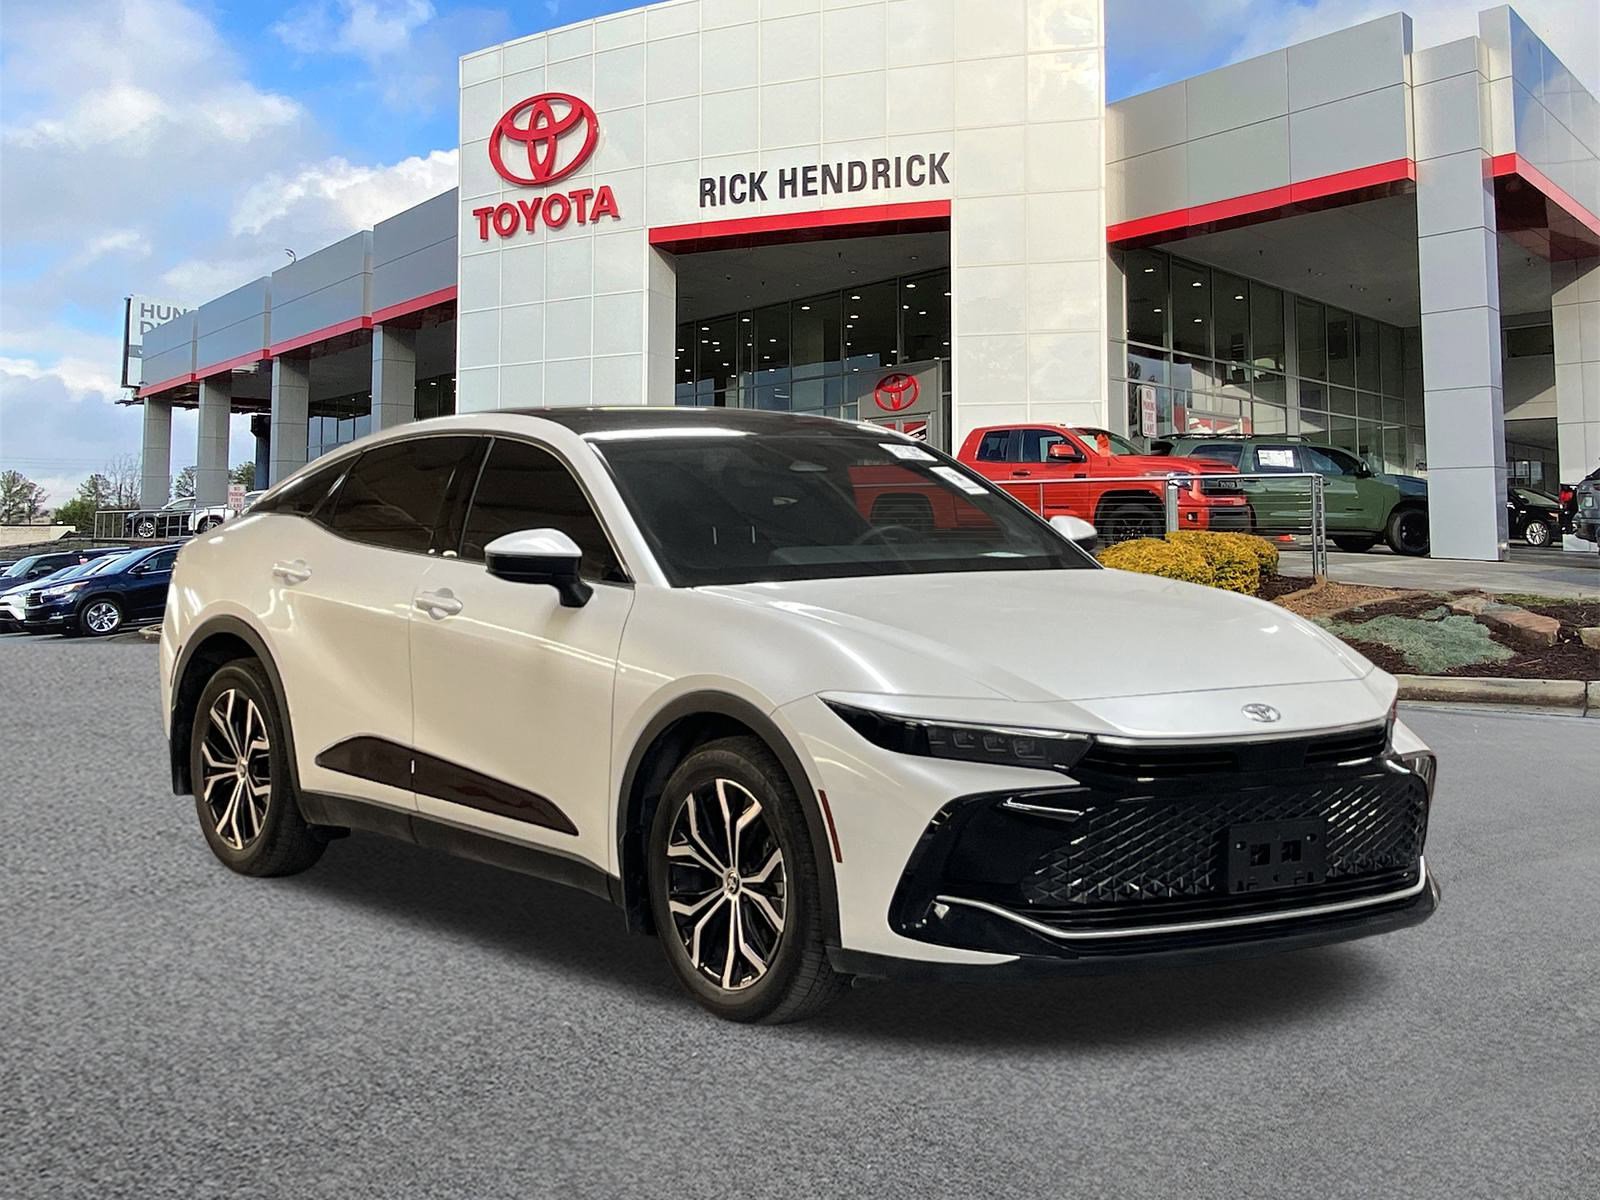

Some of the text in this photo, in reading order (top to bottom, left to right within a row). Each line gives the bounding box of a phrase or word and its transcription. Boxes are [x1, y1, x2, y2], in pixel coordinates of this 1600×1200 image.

[699, 151, 951, 208] RICK HENDRICK
[473, 185, 620, 240] TOYOTA
